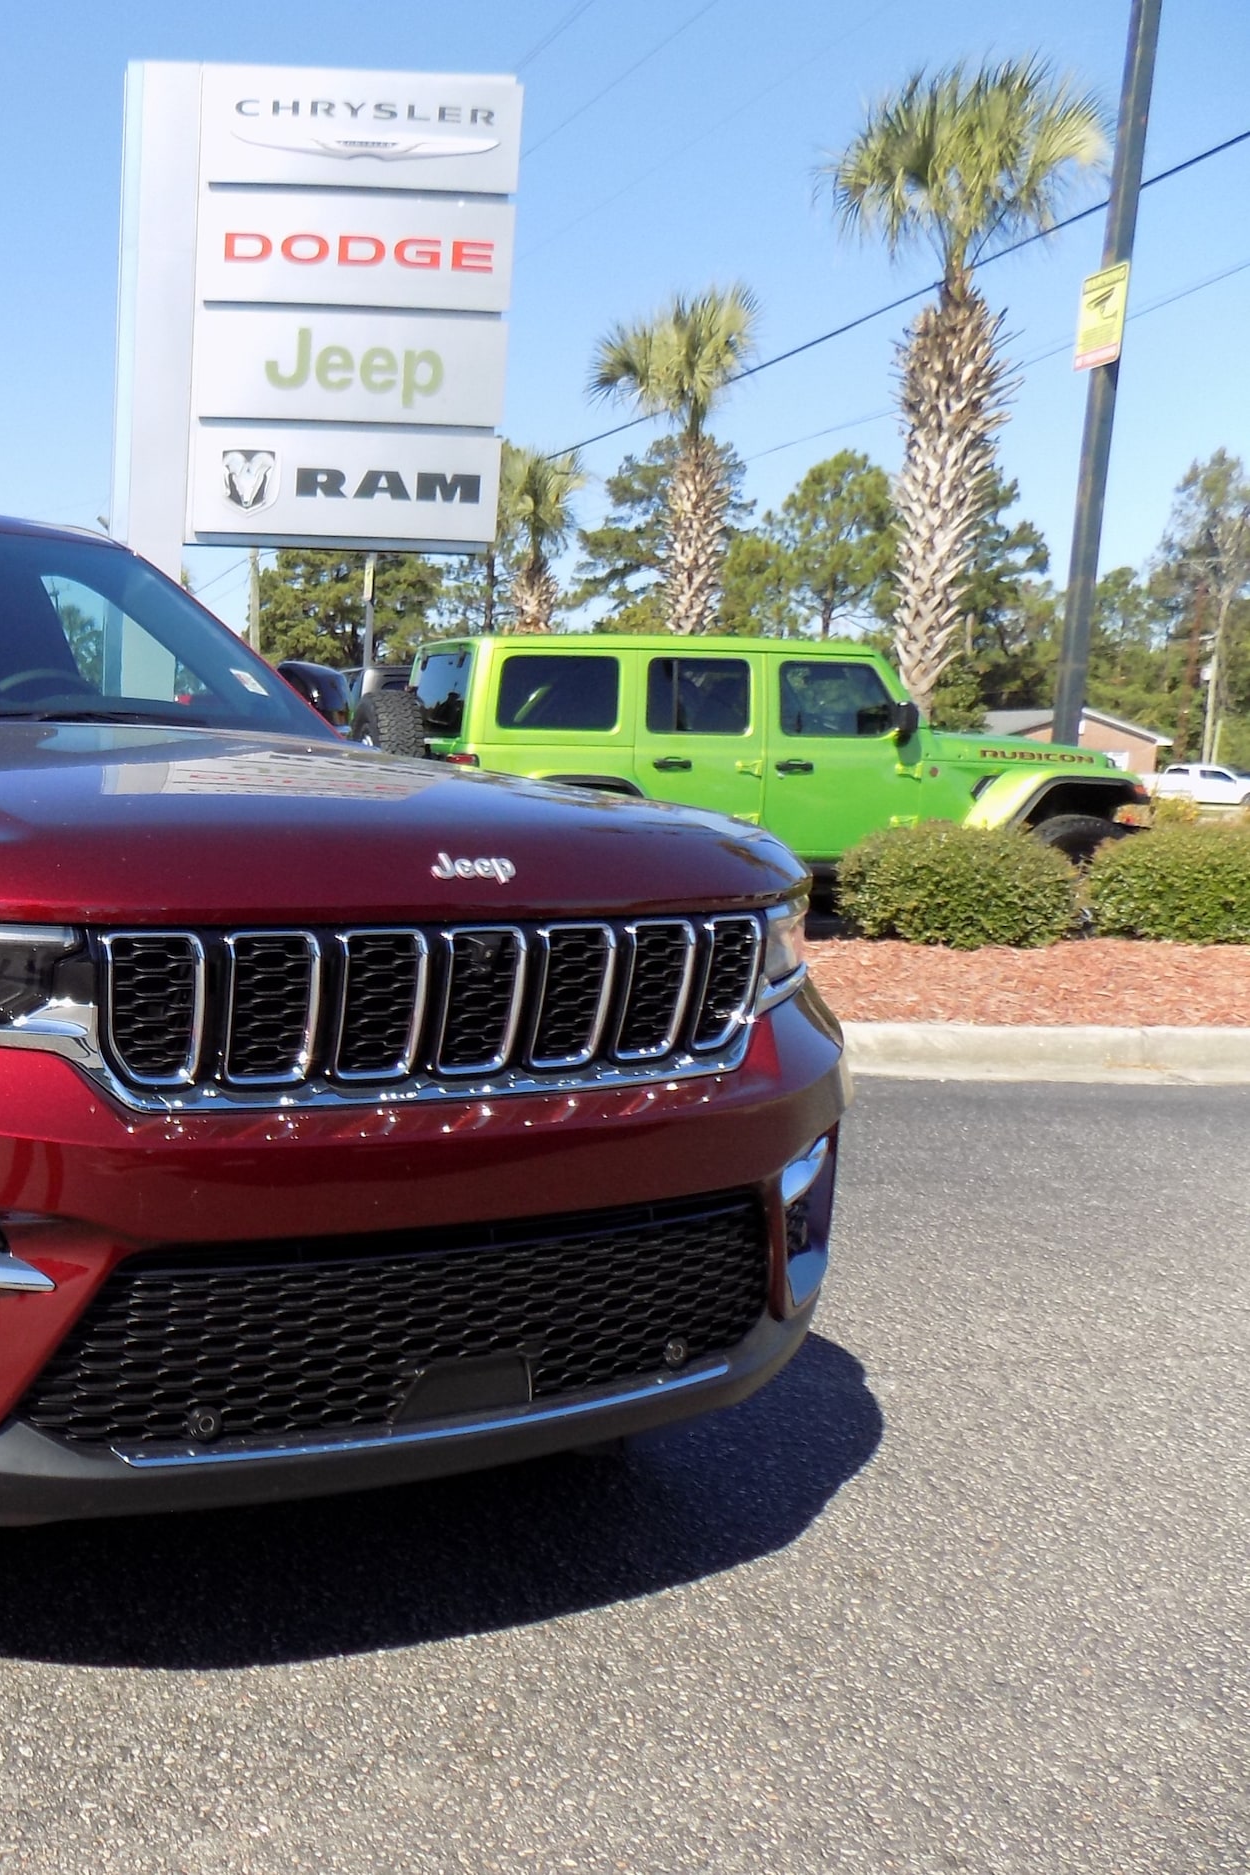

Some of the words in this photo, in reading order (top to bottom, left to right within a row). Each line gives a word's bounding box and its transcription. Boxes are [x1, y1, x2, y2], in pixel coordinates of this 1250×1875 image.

[235, 99, 495, 126] CHRYSLER
[224, 232, 494, 273] DODGE
[264, 327, 444, 408] Jeep
[295, 467, 481, 504] RAM
[979, 749, 1094, 763] RUBICON
[431, 852, 516, 885] Jeep
